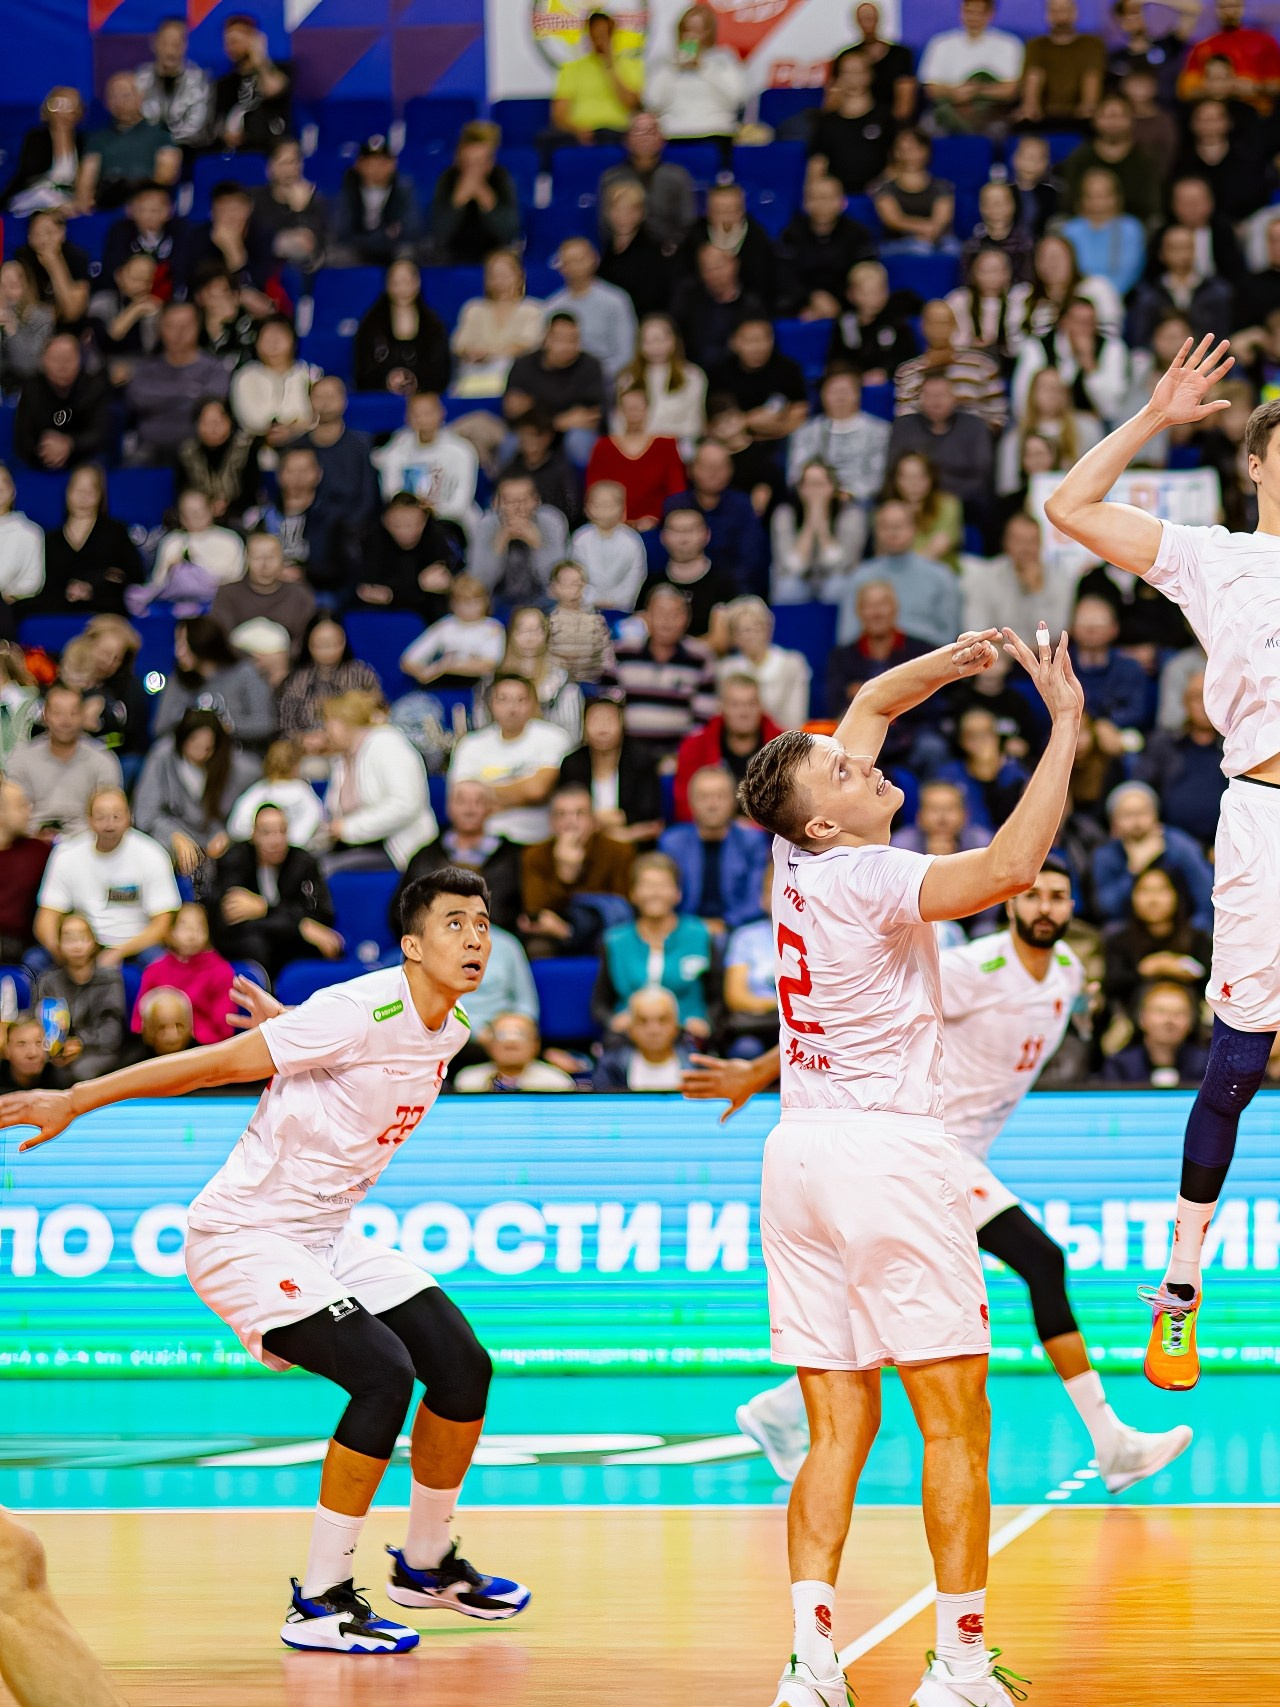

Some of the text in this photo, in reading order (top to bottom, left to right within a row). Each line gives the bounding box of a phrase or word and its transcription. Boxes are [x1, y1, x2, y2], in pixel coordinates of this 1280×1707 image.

[777, 922, 826, 1035] 2
[1014, 1035, 1045, 1072] 11
[376, 1105, 425, 1146] 22
[686, 1203, 750, 1273] И
